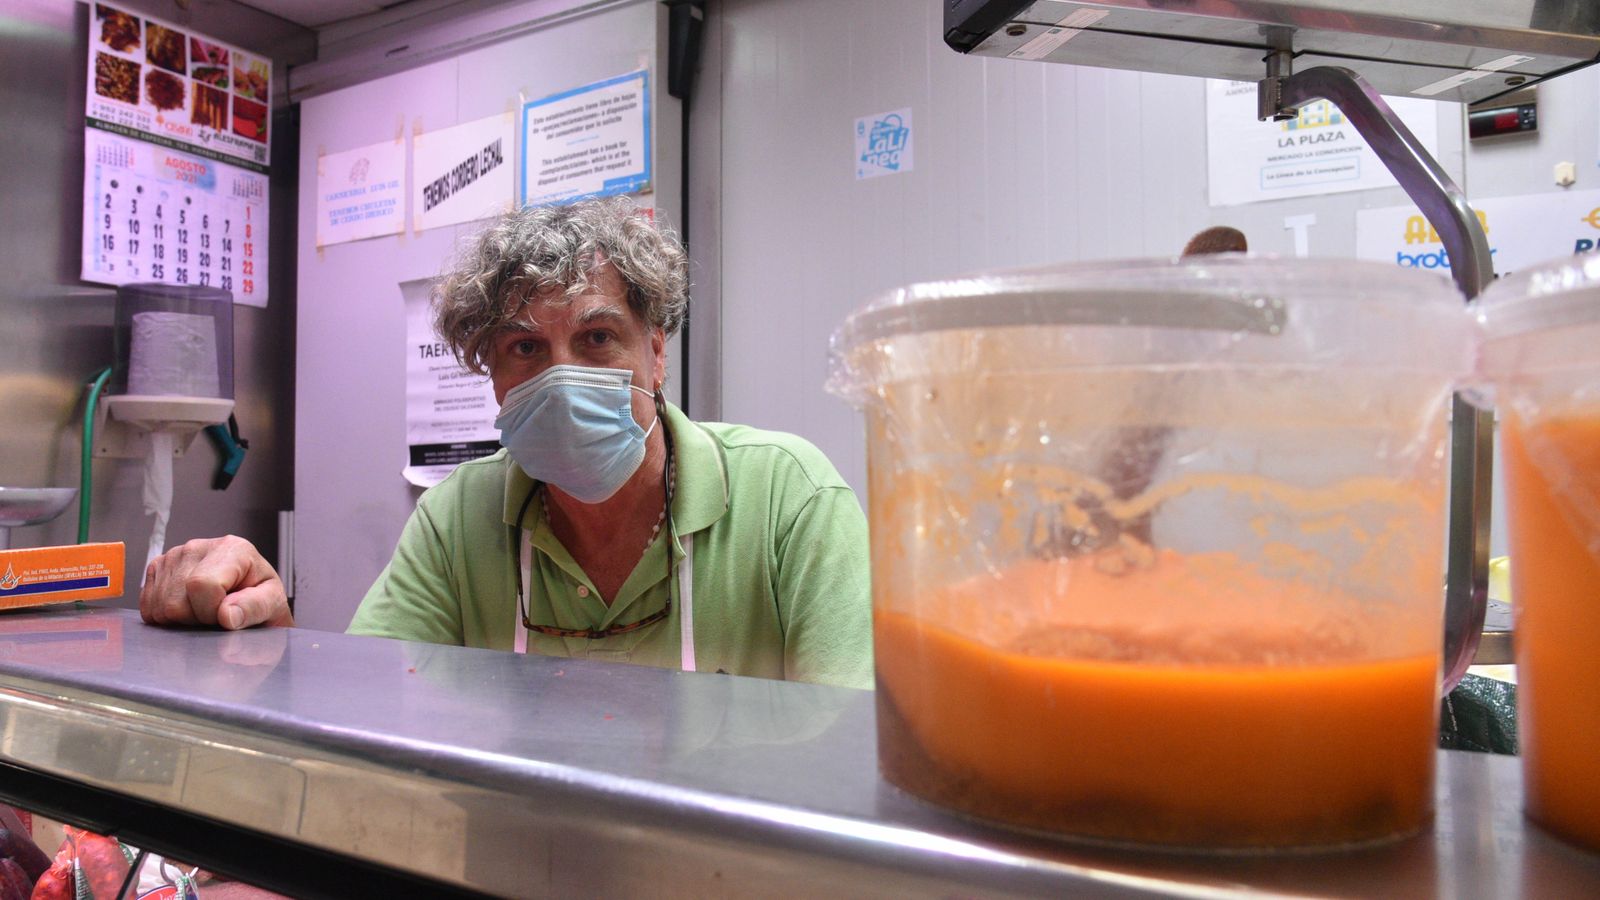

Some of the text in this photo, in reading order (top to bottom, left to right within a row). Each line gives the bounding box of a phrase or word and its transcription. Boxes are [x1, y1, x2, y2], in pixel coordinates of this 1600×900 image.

[546, 106, 584, 122] establecimiento
[586, 102, 598, 110] tiene
[600, 98, 612, 106] libro
[622, 93, 636, 102] hojas
[606, 102, 637, 115] disposición
[556, 126, 584, 138] consumidor
[585, 123, 594, 131] que
[1278, 130, 1346, 148] LA PLAZA
[165, 157, 206, 175] AGOSTO
[542, 158, 552, 166] This
[554, 150, 588, 164] establishment
[592, 156, 606, 164] which
[1267, 152, 1304, 162] MERCADO
[176, 172, 198, 184] 2021
[424, 137, 503, 213] TENEMOS CORDERO LECHAL
[538, 176, 558, 186] disposal
[566, 168, 592, 180] consumers
[606, 162, 626, 171] request
[105, 194, 251, 239] 2 3 4 5 6 7 8
[246, 206, 251, 220] 1
[104, 214, 252, 257] 9 10 11 12 13 14 15
[103, 234, 253, 275] 16 17 18 19 20 21 22
[152, 264, 164, 279] 25
[176, 268, 188, 284] 26
[200, 272, 210, 287] 27
[222, 276, 232, 291] 28
[243, 280, 254, 294] 29
